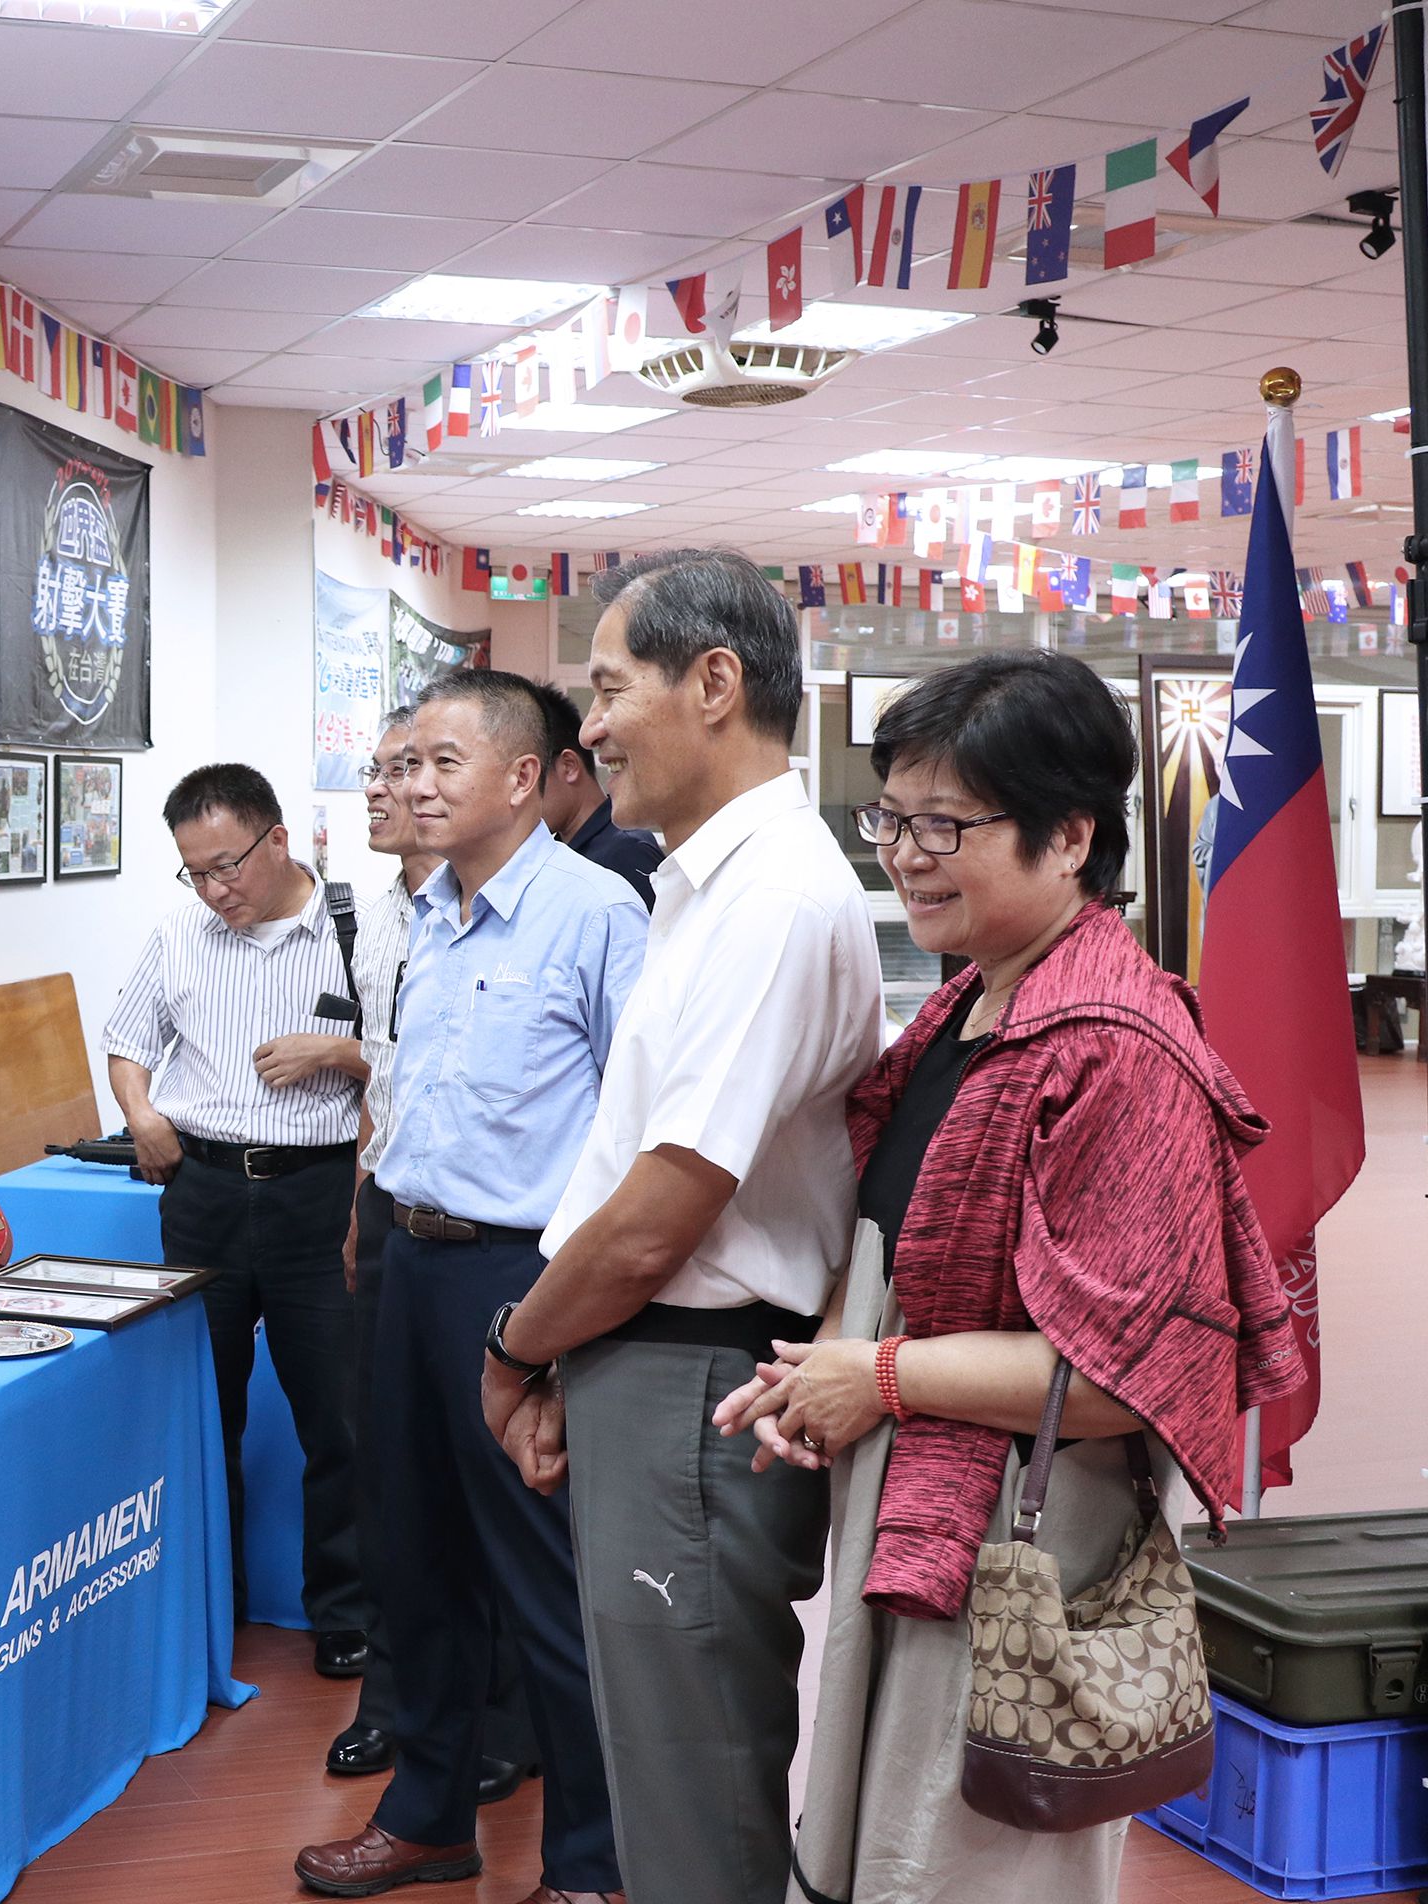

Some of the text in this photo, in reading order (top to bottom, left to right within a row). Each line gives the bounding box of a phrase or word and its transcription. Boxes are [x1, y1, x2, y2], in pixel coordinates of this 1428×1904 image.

[34, 560, 130, 644] 射擊大賽
[0, 1475, 164, 1628] ARMAMENT
[49, 1605, 60, 1633] &
